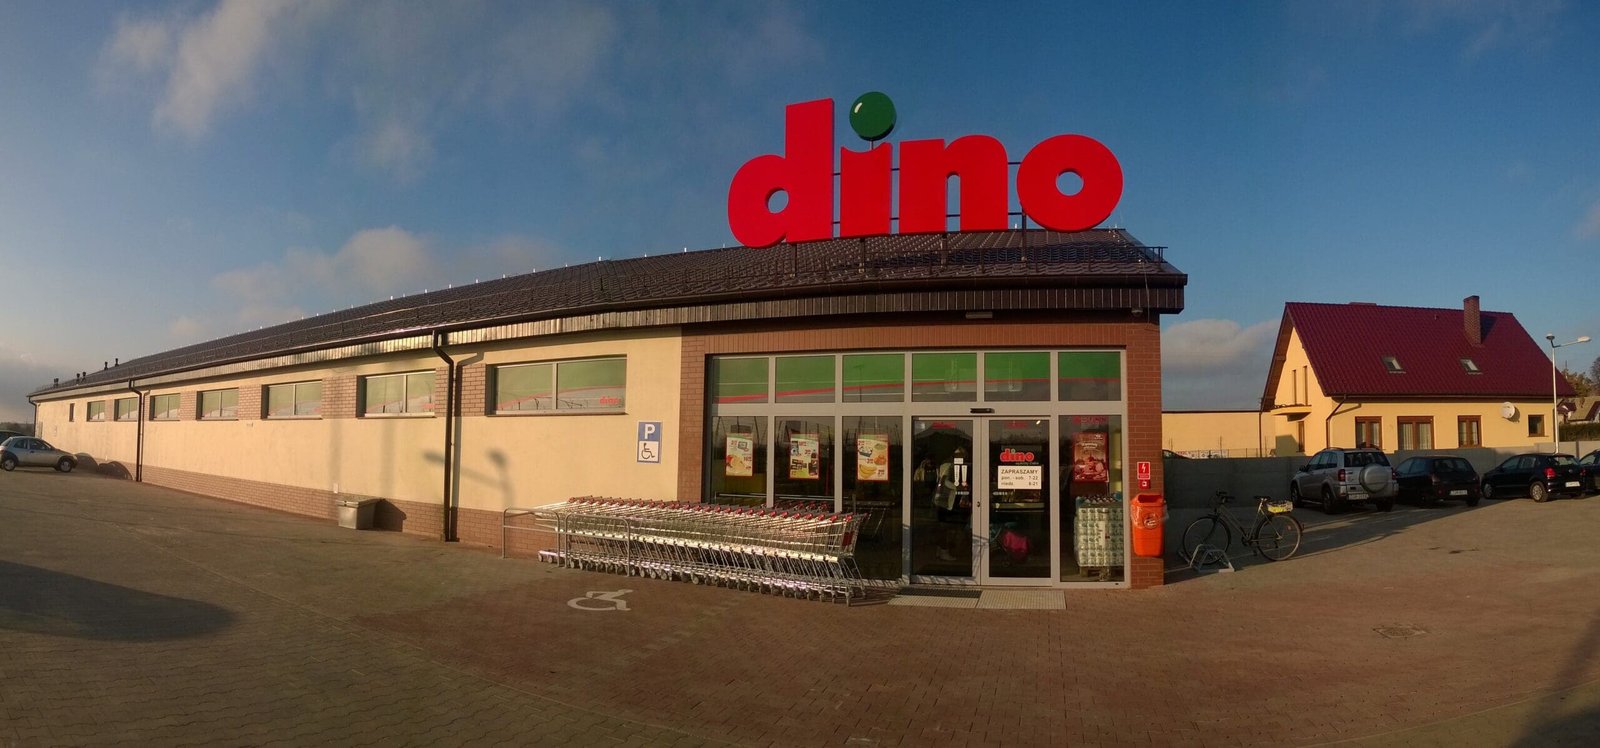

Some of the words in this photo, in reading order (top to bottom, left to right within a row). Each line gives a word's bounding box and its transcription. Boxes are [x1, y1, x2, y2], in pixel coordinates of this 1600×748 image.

[728, 91, 1124, 248] dino
[644, 423, 656, 439] P
[1000, 448, 1034, 462] dino
